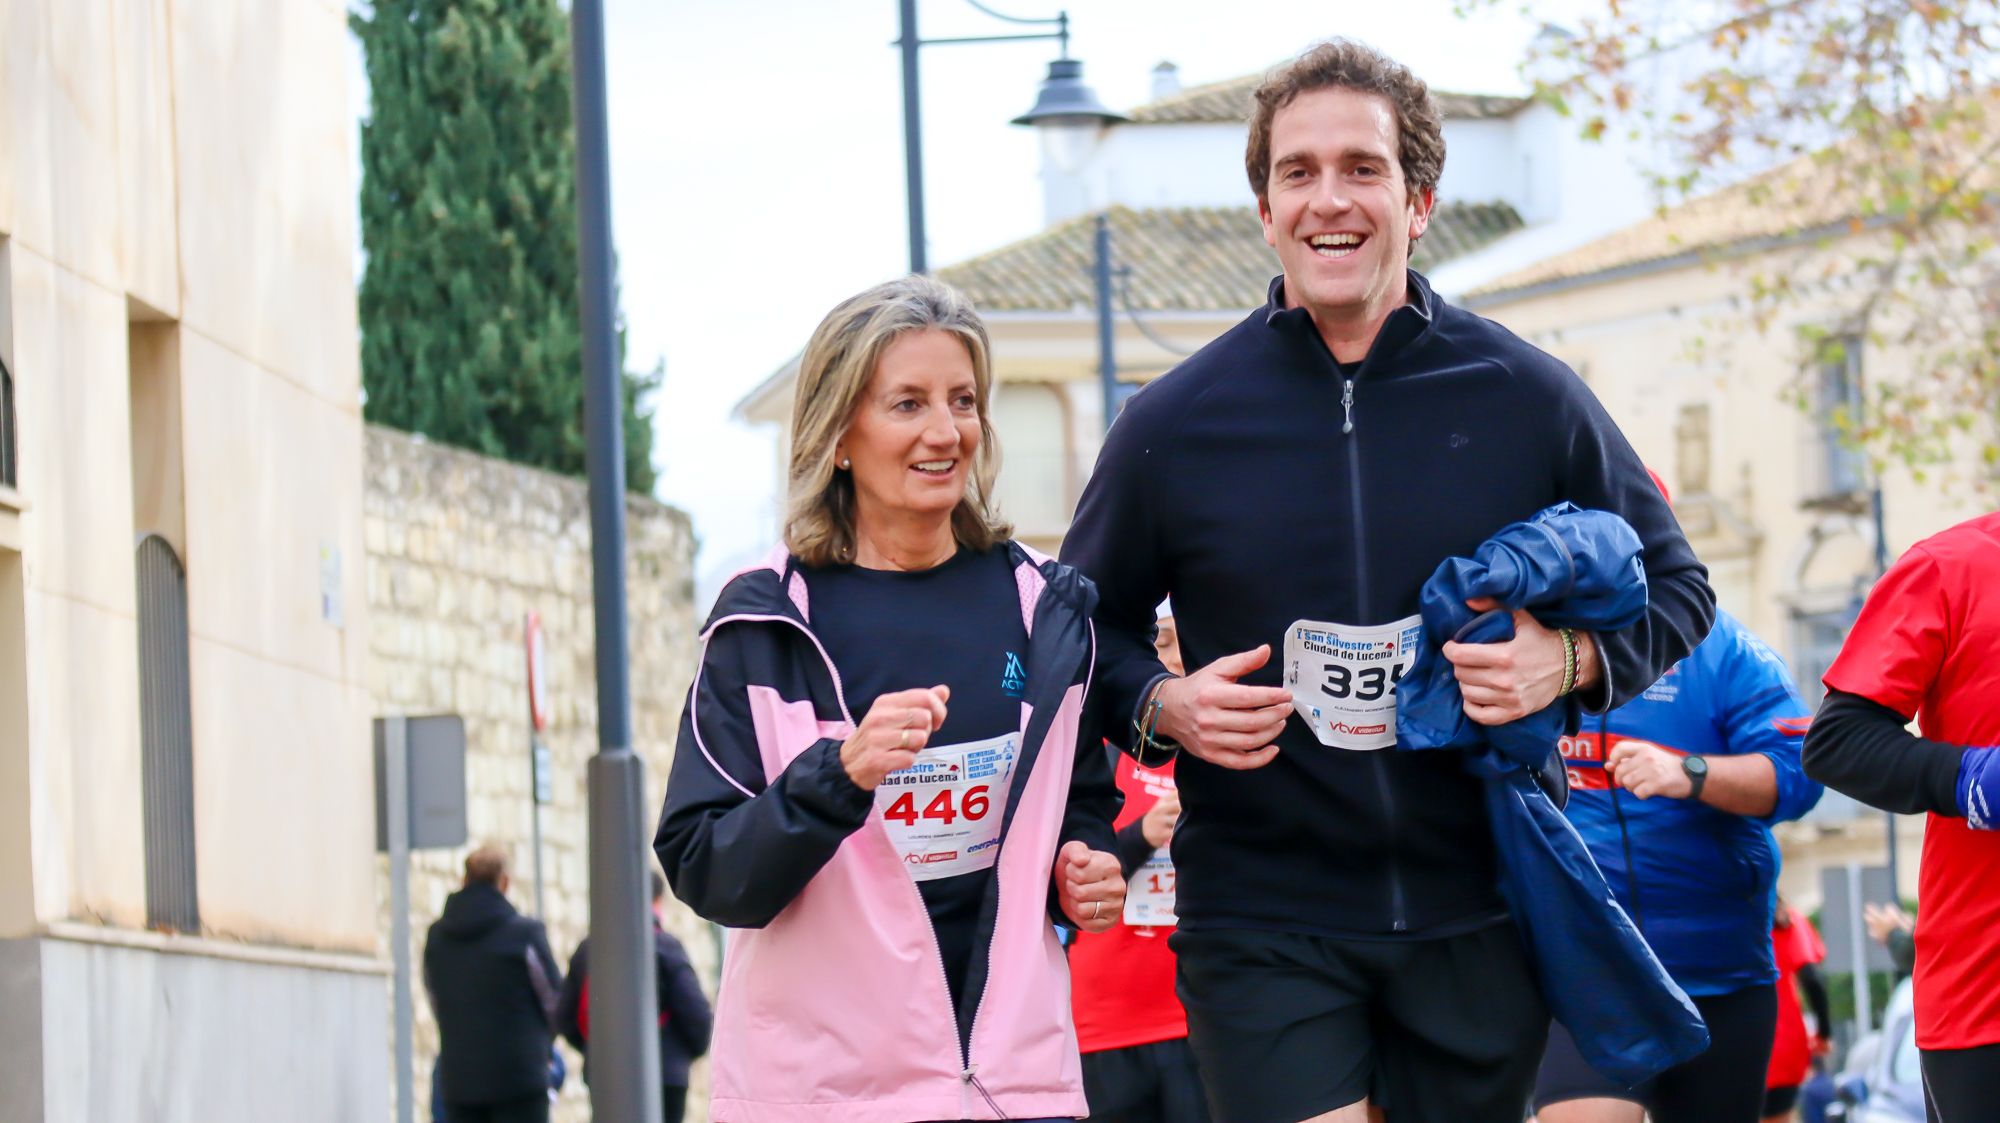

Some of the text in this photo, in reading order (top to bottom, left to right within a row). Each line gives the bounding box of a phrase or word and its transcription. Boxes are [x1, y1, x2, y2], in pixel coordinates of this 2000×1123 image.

[1305, 630, 1324, 643] San
[1327, 635, 1373, 650] Silvestre
[1304, 641, 1339, 657] Ciudad
[1341, 650, 1354, 660] de
[1356, 650, 1393, 661] Lucena
[903, 775, 916, 784] de
[919, 774, 958, 784] Lucena
[883, 785, 990, 826] 446
